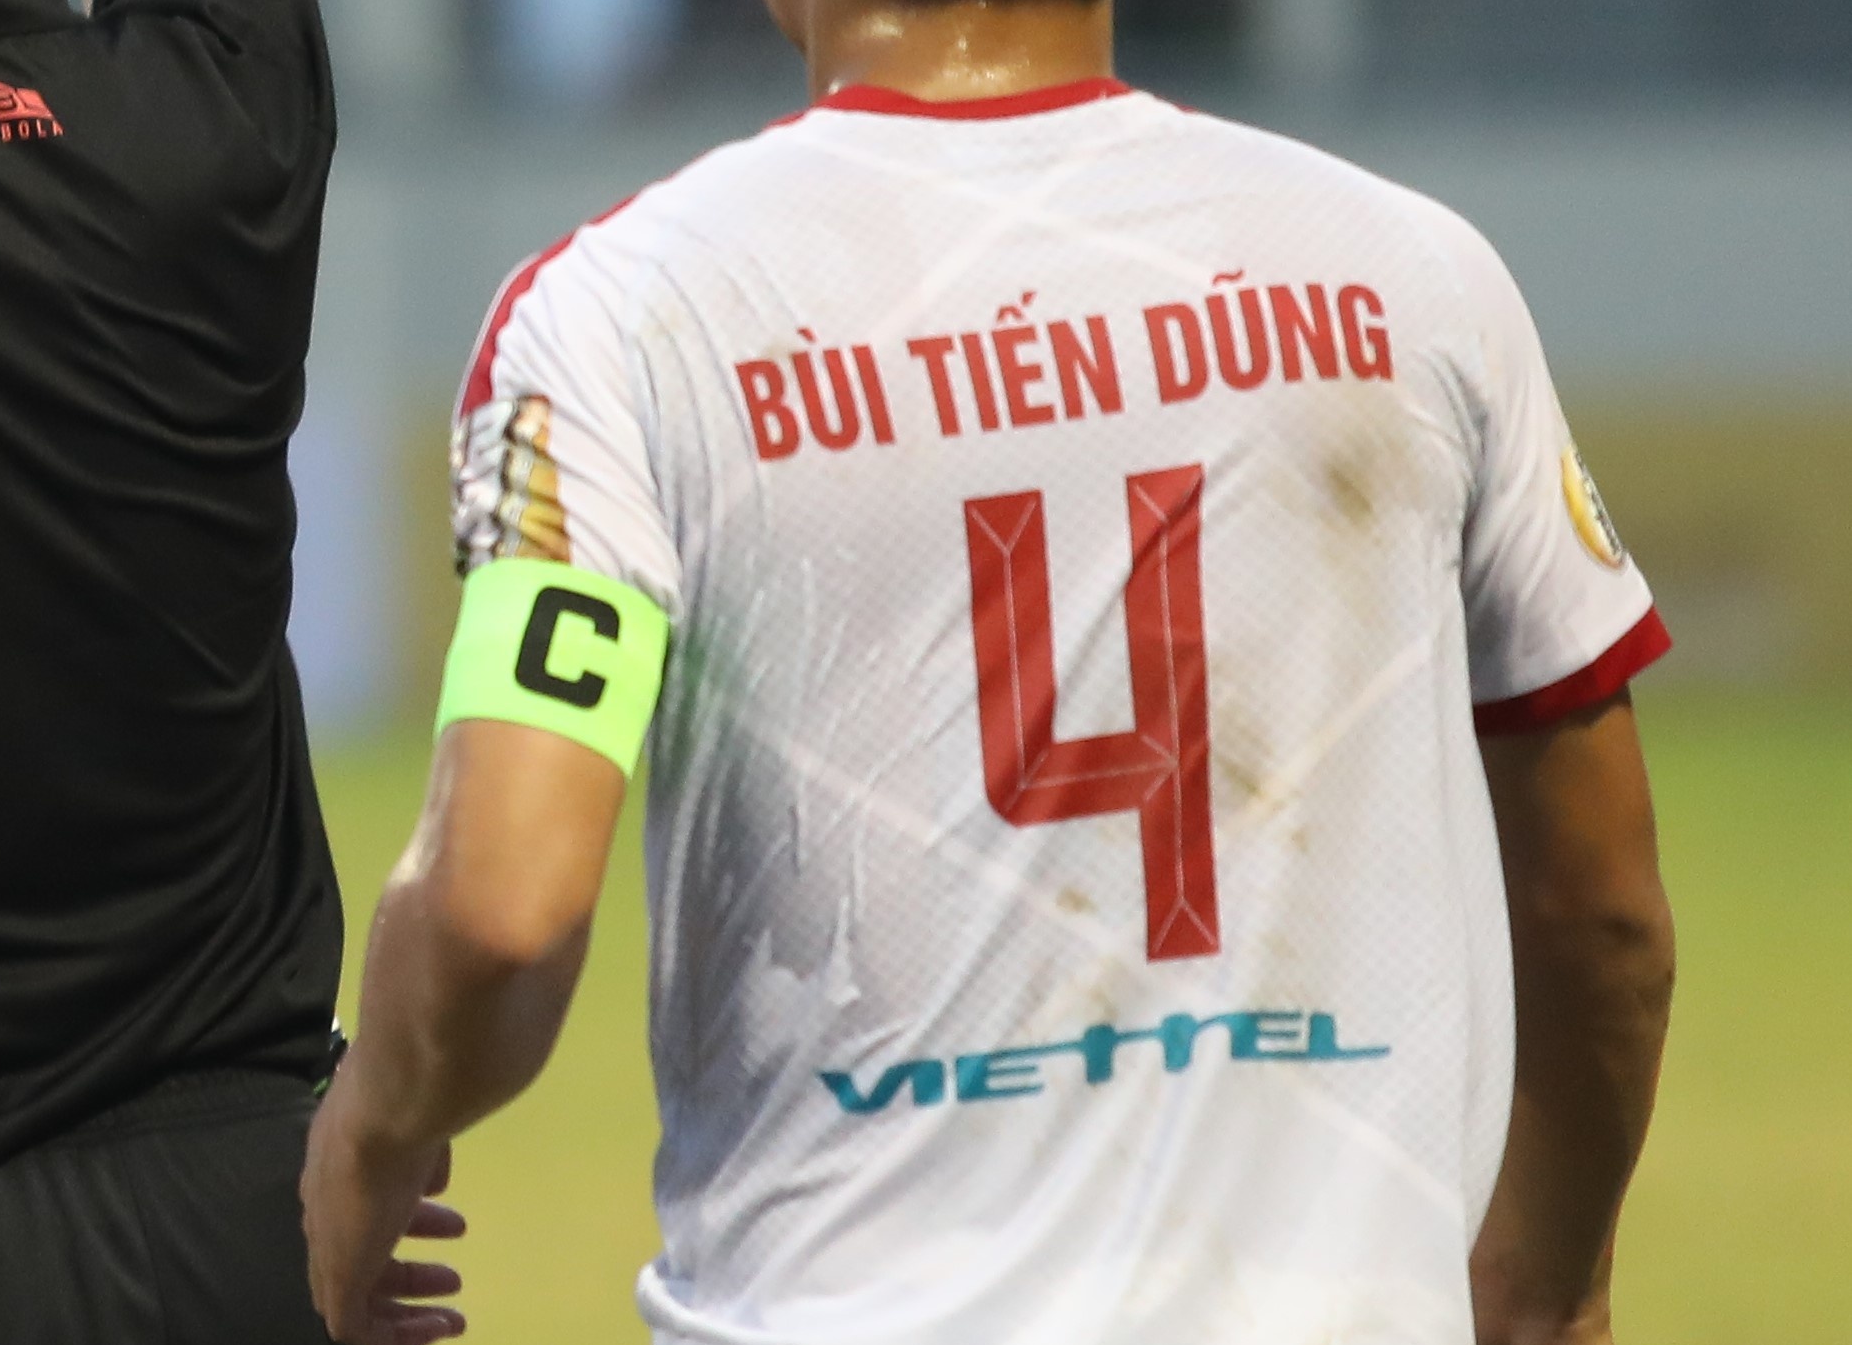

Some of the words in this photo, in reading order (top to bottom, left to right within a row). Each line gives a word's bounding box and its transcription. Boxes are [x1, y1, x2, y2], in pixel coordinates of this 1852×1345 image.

[734, 327, 896, 462] BÙI
[908, 292, 1123, 436] TIẾN
[1143, 268, 1394, 404] DŨNG
[515, 586, 620, 710] C
[963, 463, 1220, 963] 4
